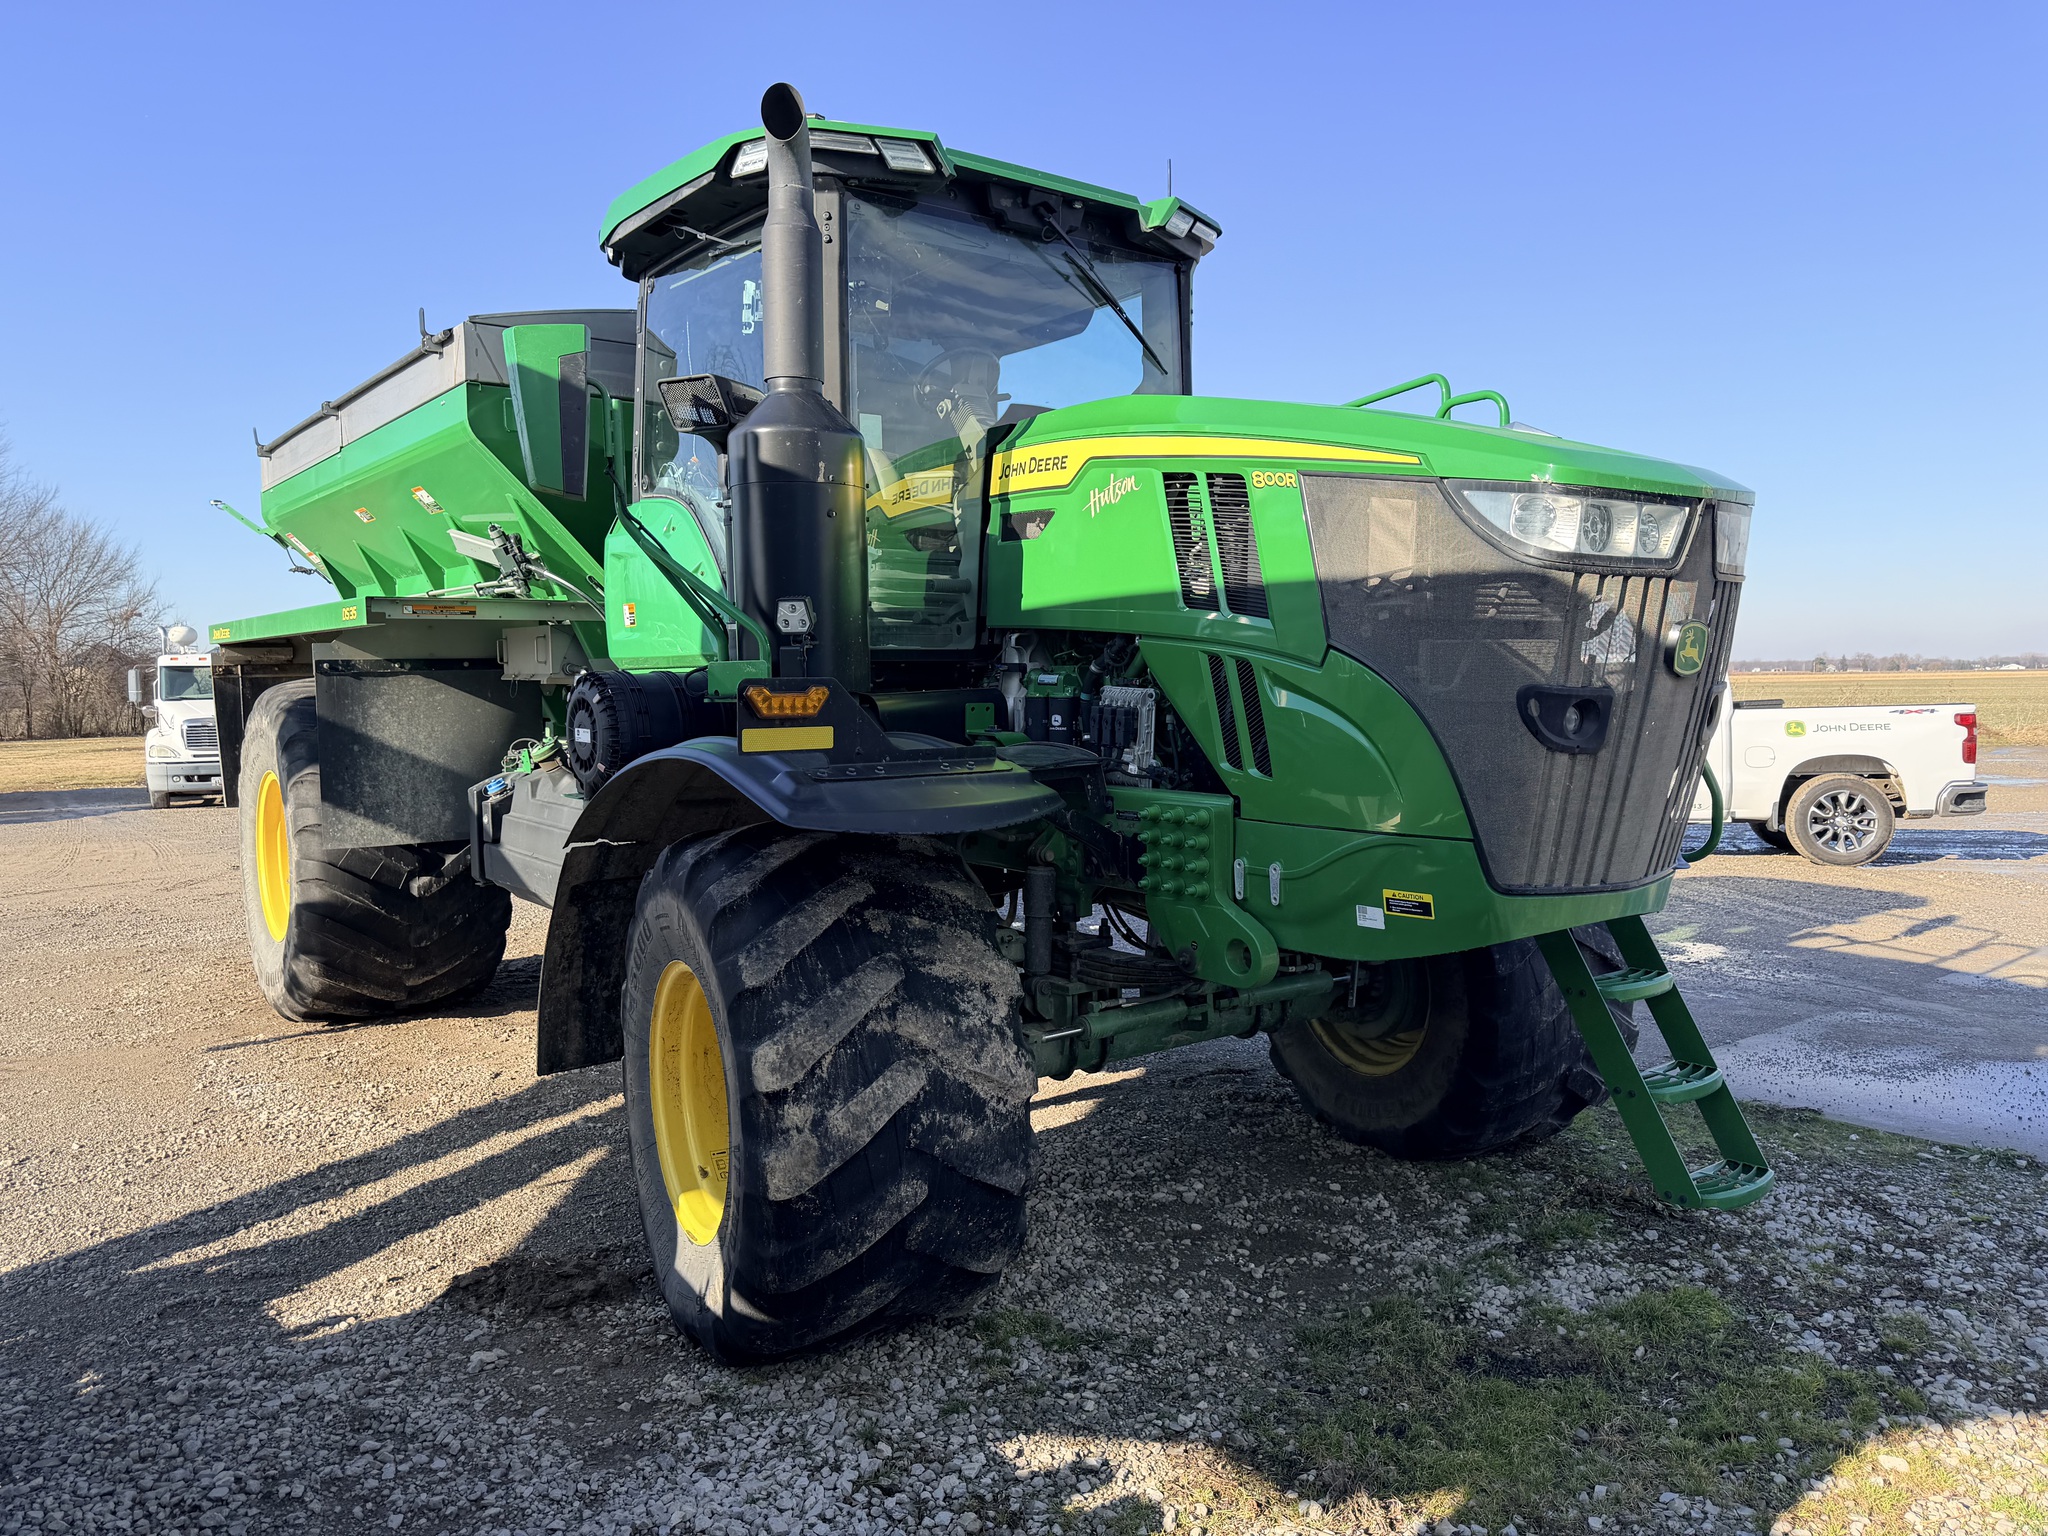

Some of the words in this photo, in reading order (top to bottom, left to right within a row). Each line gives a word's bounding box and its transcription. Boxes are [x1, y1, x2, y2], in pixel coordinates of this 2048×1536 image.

[998, 461, 1027, 480] JOHN
[1028, 455, 1069, 474] DEERE
[1251, 470, 1298, 489] 800R
[1082, 473, 1143, 518] Hutson
[1812, 723, 1847, 733] JOHN
[1849, 722, 1892, 732] DEERE
[1397, 892, 1424, 901] CAUTION
